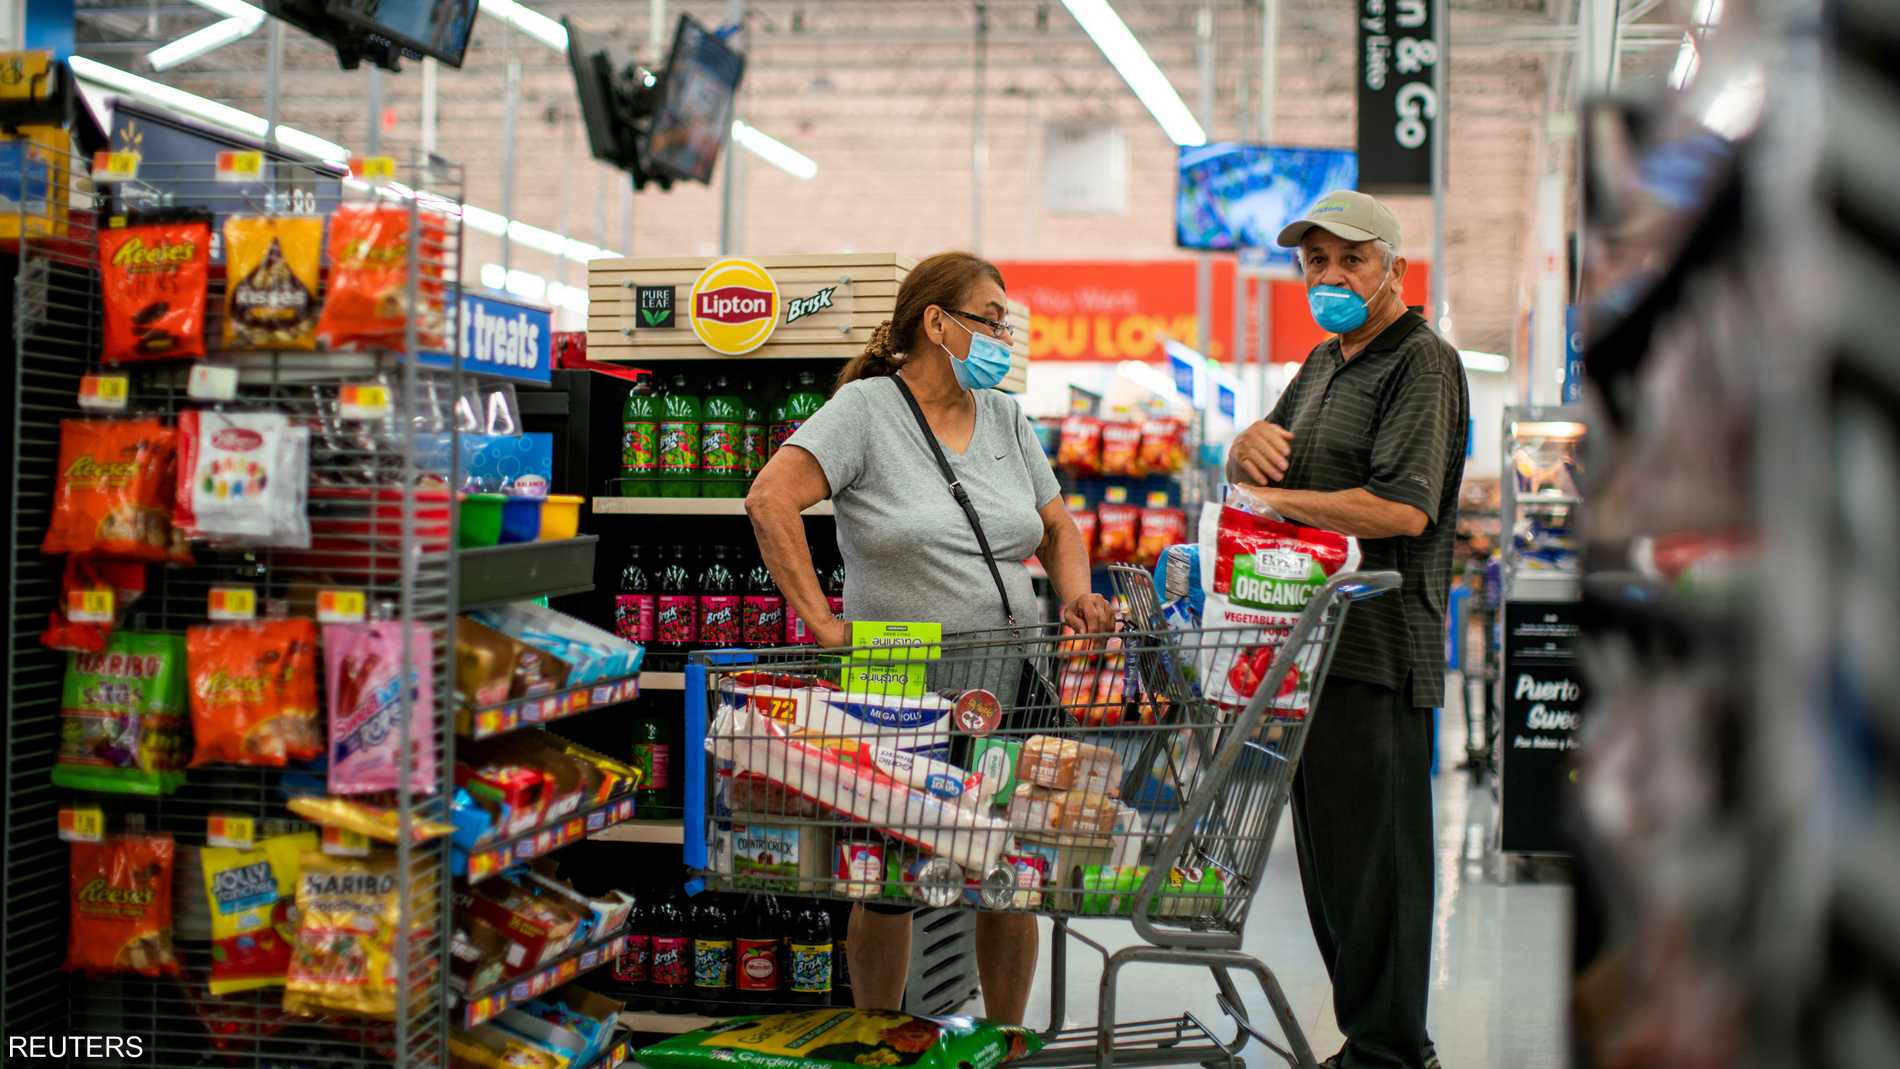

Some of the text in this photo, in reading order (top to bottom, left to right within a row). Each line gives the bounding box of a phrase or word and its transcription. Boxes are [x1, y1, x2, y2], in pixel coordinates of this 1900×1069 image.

[1366, 35, 1391, 90] Listo
[1395, 36, 1438, 75] &
[1394, 81, 1438, 149] Go
[642, 289, 670, 300] PURE
[642, 298, 670, 308] LEAF
[702, 295, 766, 317] Lipton
[786, 286, 837, 324] Brisk
[474, 303, 539, 370] treats
[1028, 314, 1089, 358] OU
[706, 606, 732, 625] Brisk
[1224, 611, 1276, 625] VEGETABLE
[1515, 673, 1580, 701] Puerto
[770, 700, 796, 720] 72
